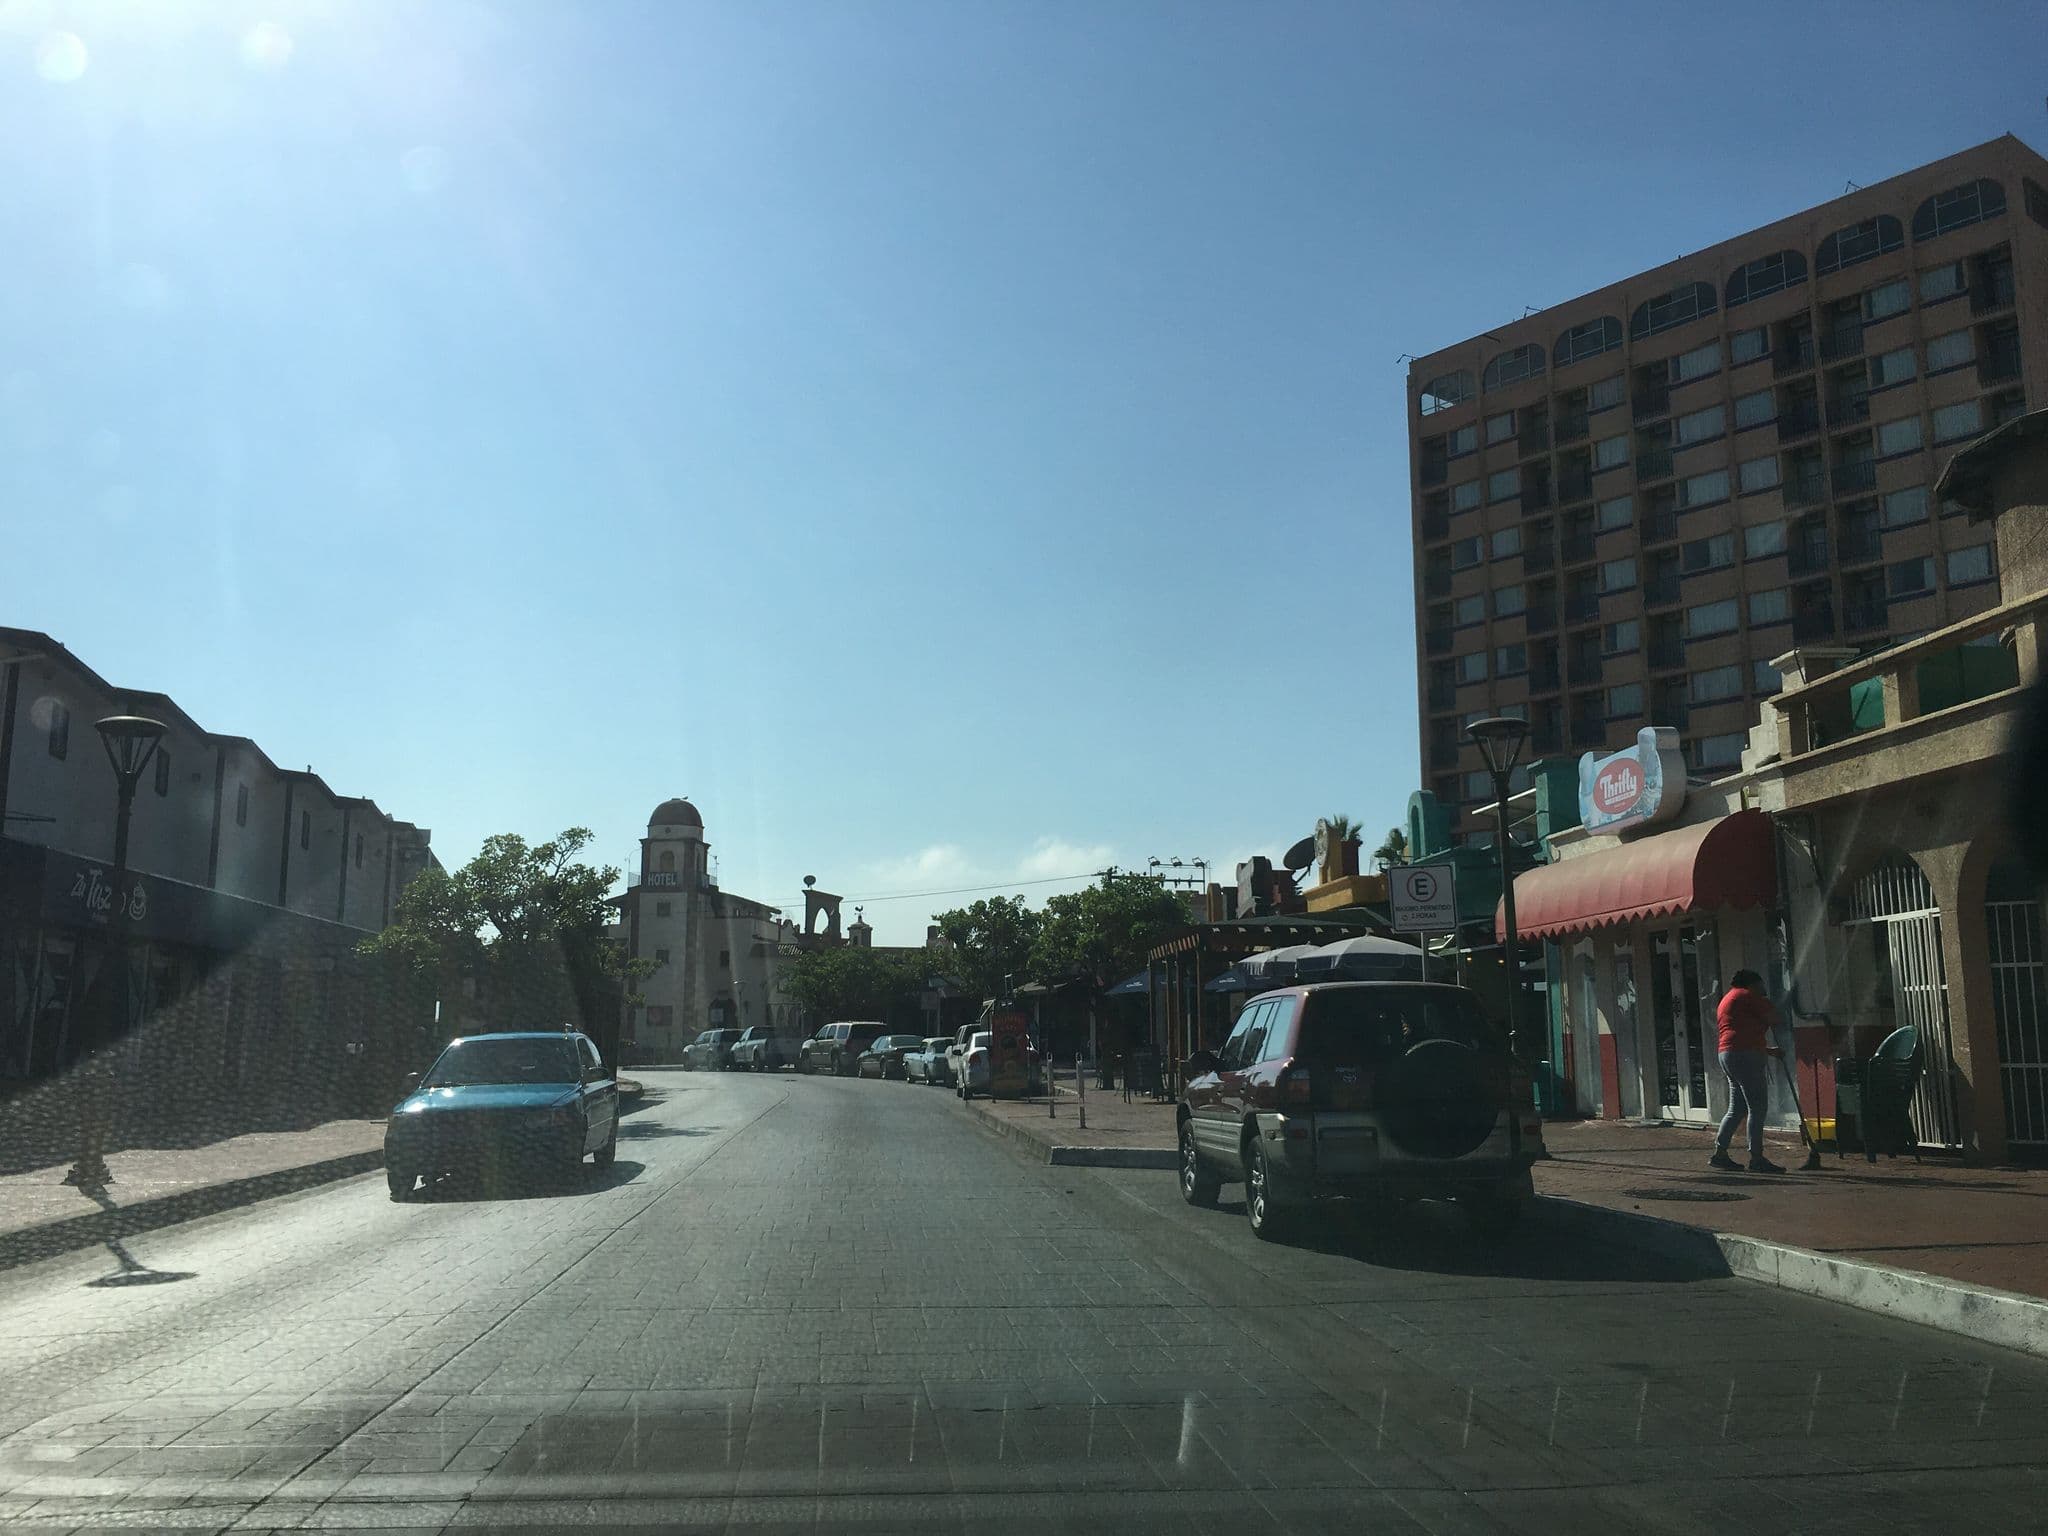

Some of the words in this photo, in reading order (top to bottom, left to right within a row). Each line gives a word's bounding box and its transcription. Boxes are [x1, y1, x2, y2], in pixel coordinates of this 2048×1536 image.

[1600, 768, 1637, 802] Thrifty
[648, 873, 676, 887] HOTEL
[1415, 878, 1429, 896] E
